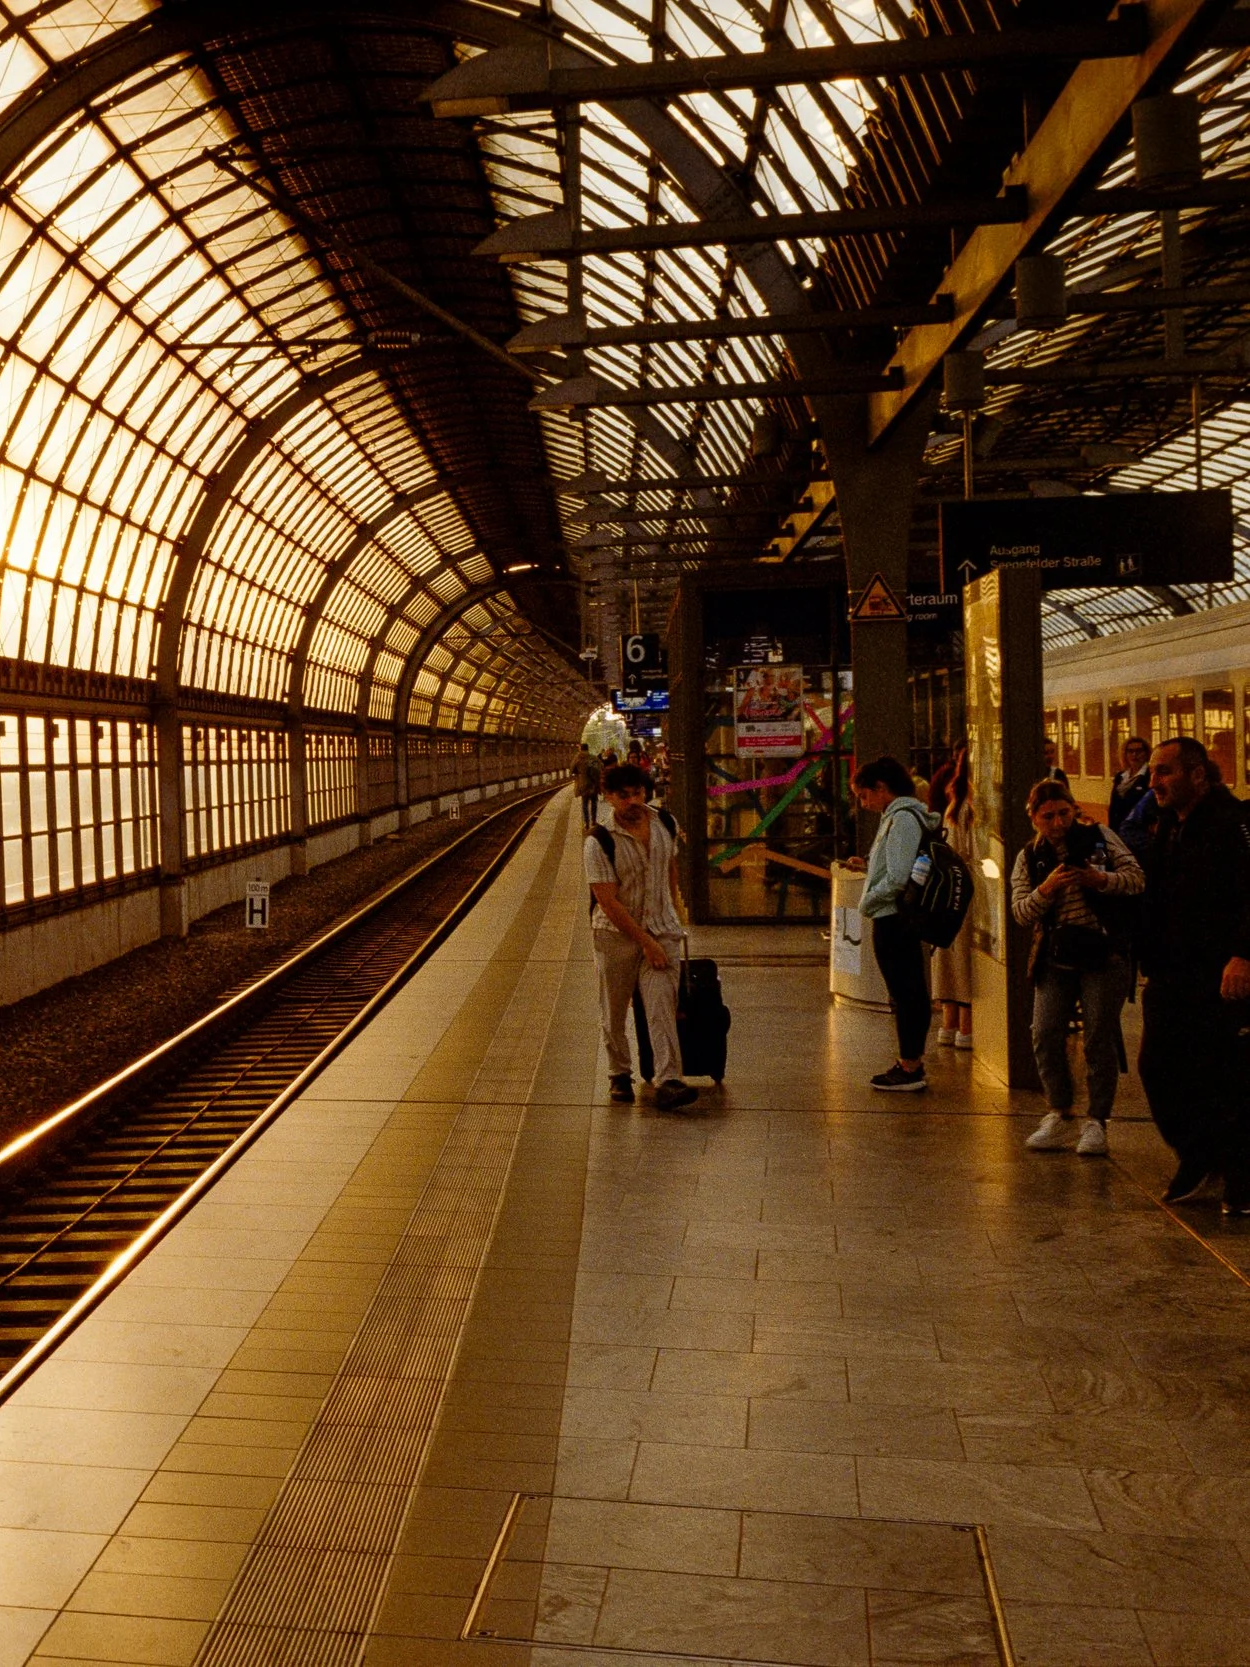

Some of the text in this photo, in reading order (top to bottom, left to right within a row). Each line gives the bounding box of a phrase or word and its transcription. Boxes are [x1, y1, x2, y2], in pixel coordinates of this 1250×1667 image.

[989, 544, 1041, 557] Ausgang
[1063, 556, 1102, 568] Straße
[626, 634, 646, 663] 6
[249, 898, 267, 926] H
